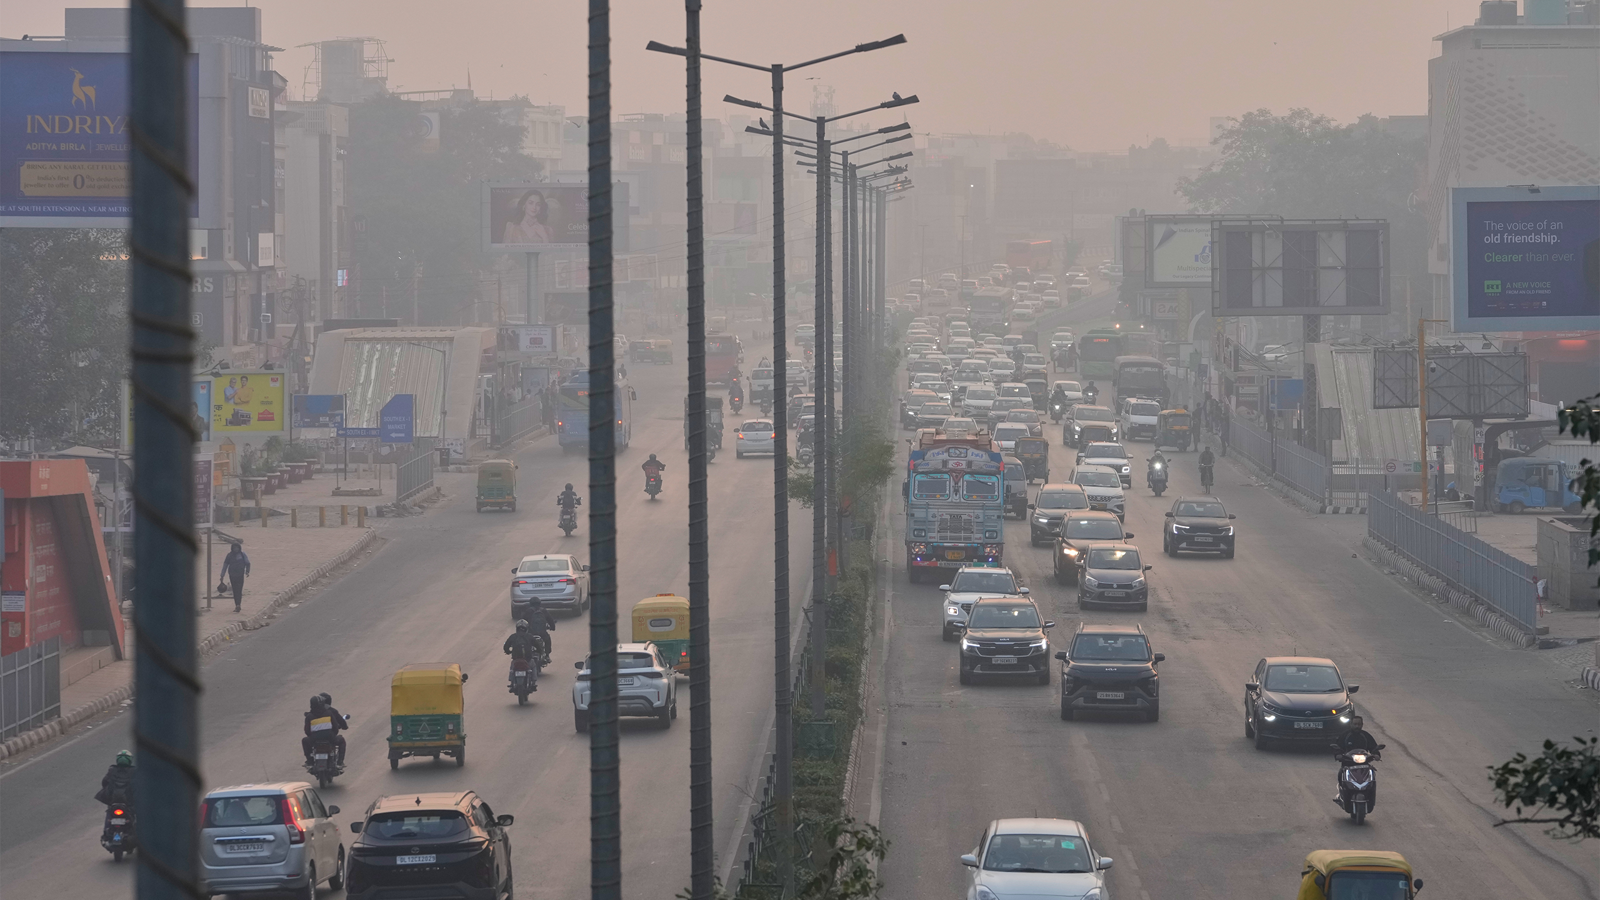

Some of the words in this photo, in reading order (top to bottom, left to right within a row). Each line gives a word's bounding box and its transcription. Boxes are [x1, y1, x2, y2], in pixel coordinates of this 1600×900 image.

[26, 143, 57, 151] ADITYA
[60, 143, 86, 151] BIRLA
[95, 143, 131, 151] JEWELLE
[1484, 220, 1504, 231] The
[1506, 220, 1534, 230] voice
[1536, 219, 1548, 230] of
[1550, 221, 1563, 230] an
[1484, 233, 1501, 244] old
[1503, 232, 1561, 245] friendship.
[1484, 252, 1523, 263] Clearer
[1526, 252, 1549, 262] than
[1551, 253, 1576, 262] ever.
